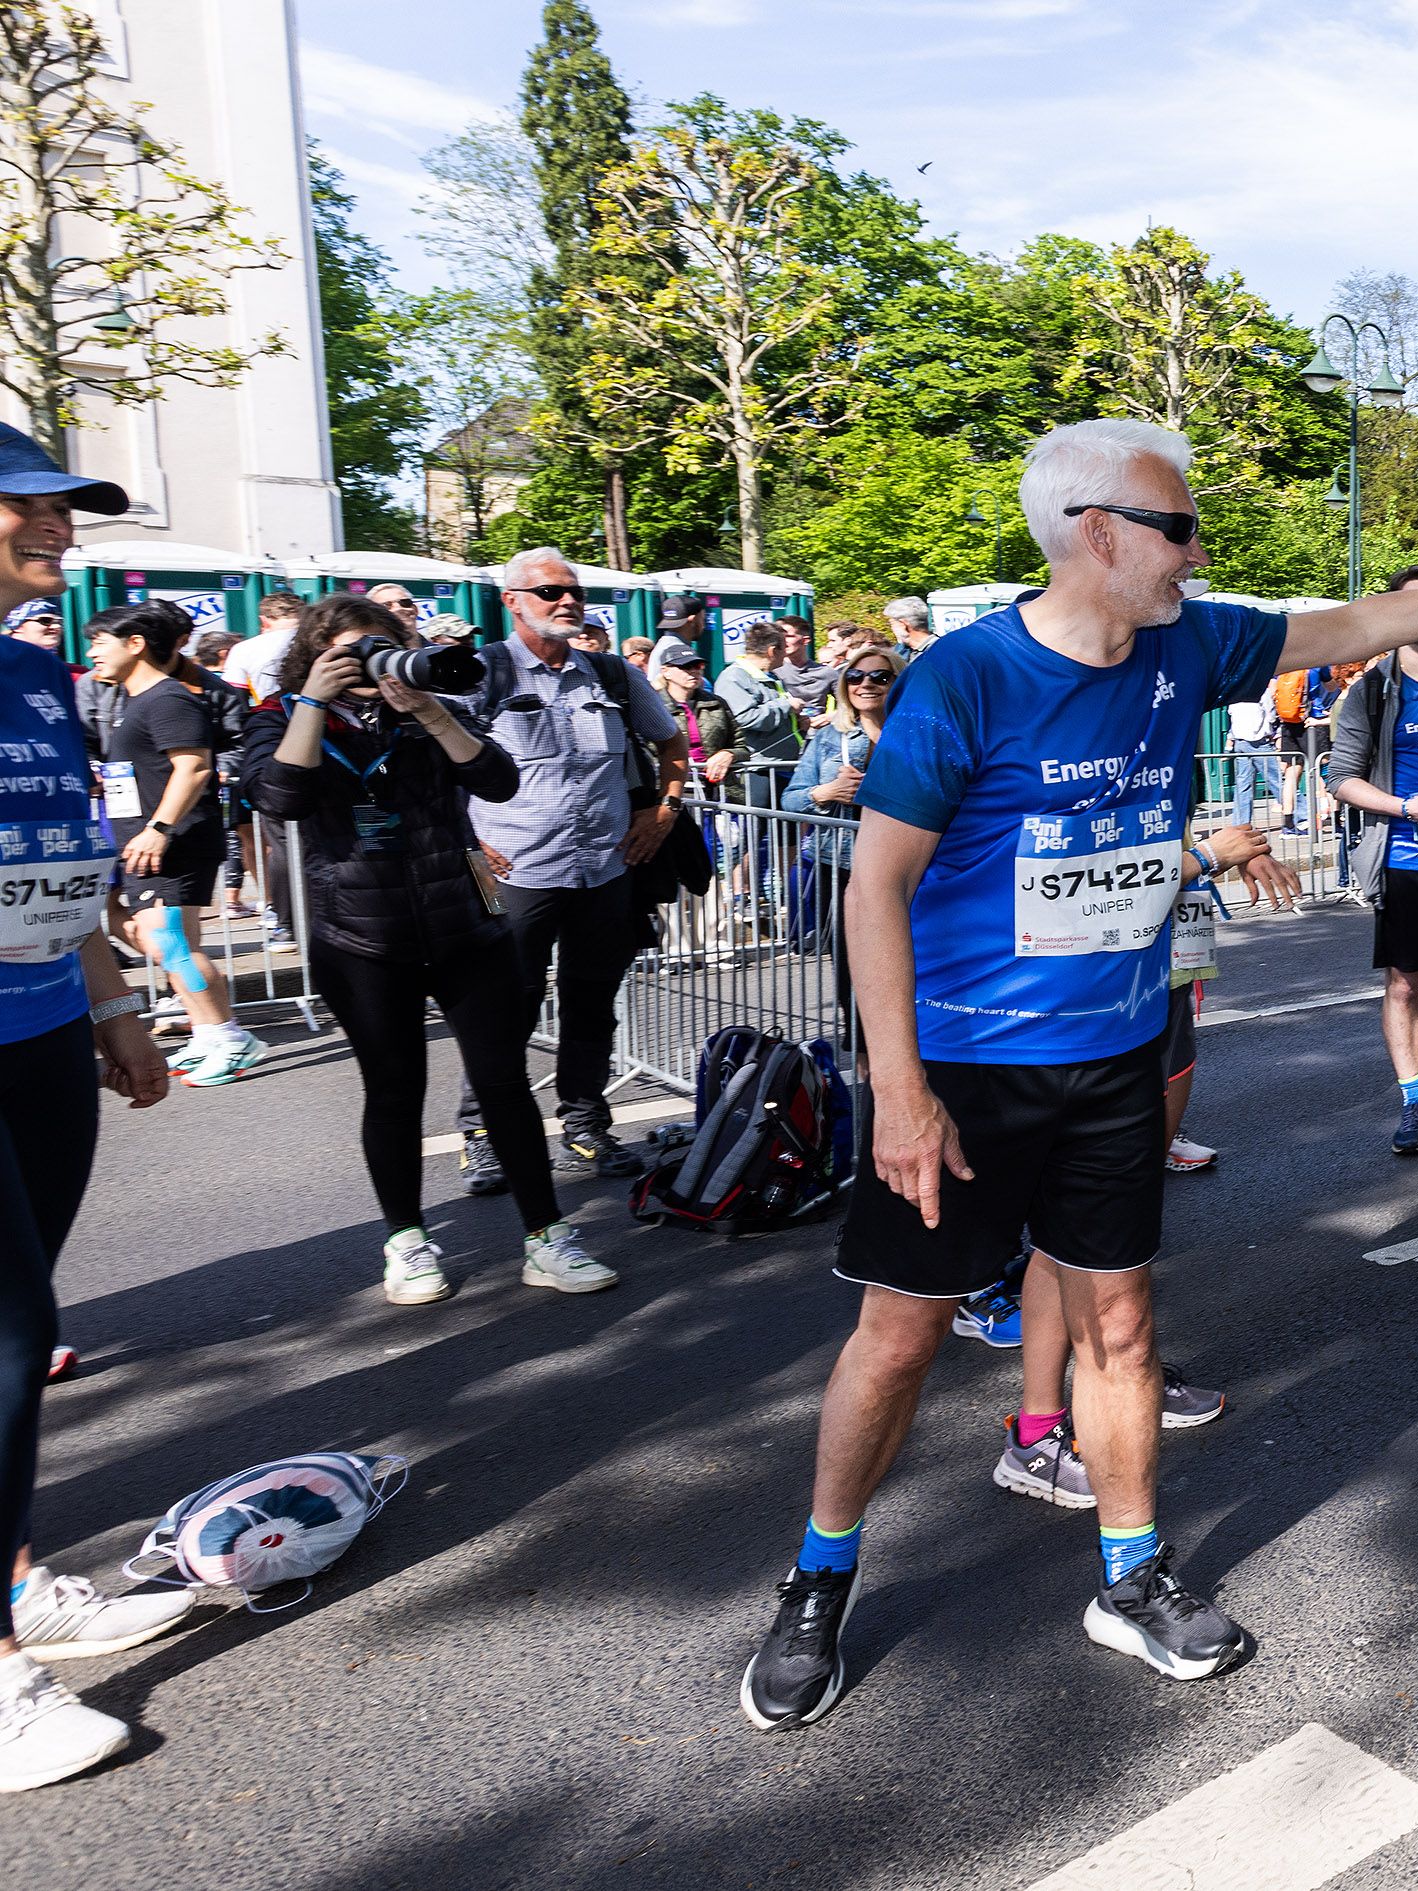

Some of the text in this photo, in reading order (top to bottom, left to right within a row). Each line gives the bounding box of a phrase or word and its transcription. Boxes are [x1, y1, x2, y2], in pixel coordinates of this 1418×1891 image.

[31, 739, 59, 758] in
[1040, 755, 1129, 784] Energy
[1091, 812, 1116, 833] uni
[1139, 804, 1161, 825] uni
[37, 824, 70, 842] uni
[1095, 826, 1124, 848] per
[1143, 819, 1172, 839] per
[42, 839, 81, 858] per
[1034, 836, 1073, 854] per
[1022, 858, 1178, 901] J S7422 2
[0, 872, 101, 907] S7425
[1082, 898, 1134, 917] UNIPER
[1034, 935, 1089, 943] Stadtsparkasse
[925, 999, 941, 1008] The
[943, 1002, 976, 1015] beating
[978, 1007, 1005, 1016] heart
[1006, 1008, 1018, 1017] of
